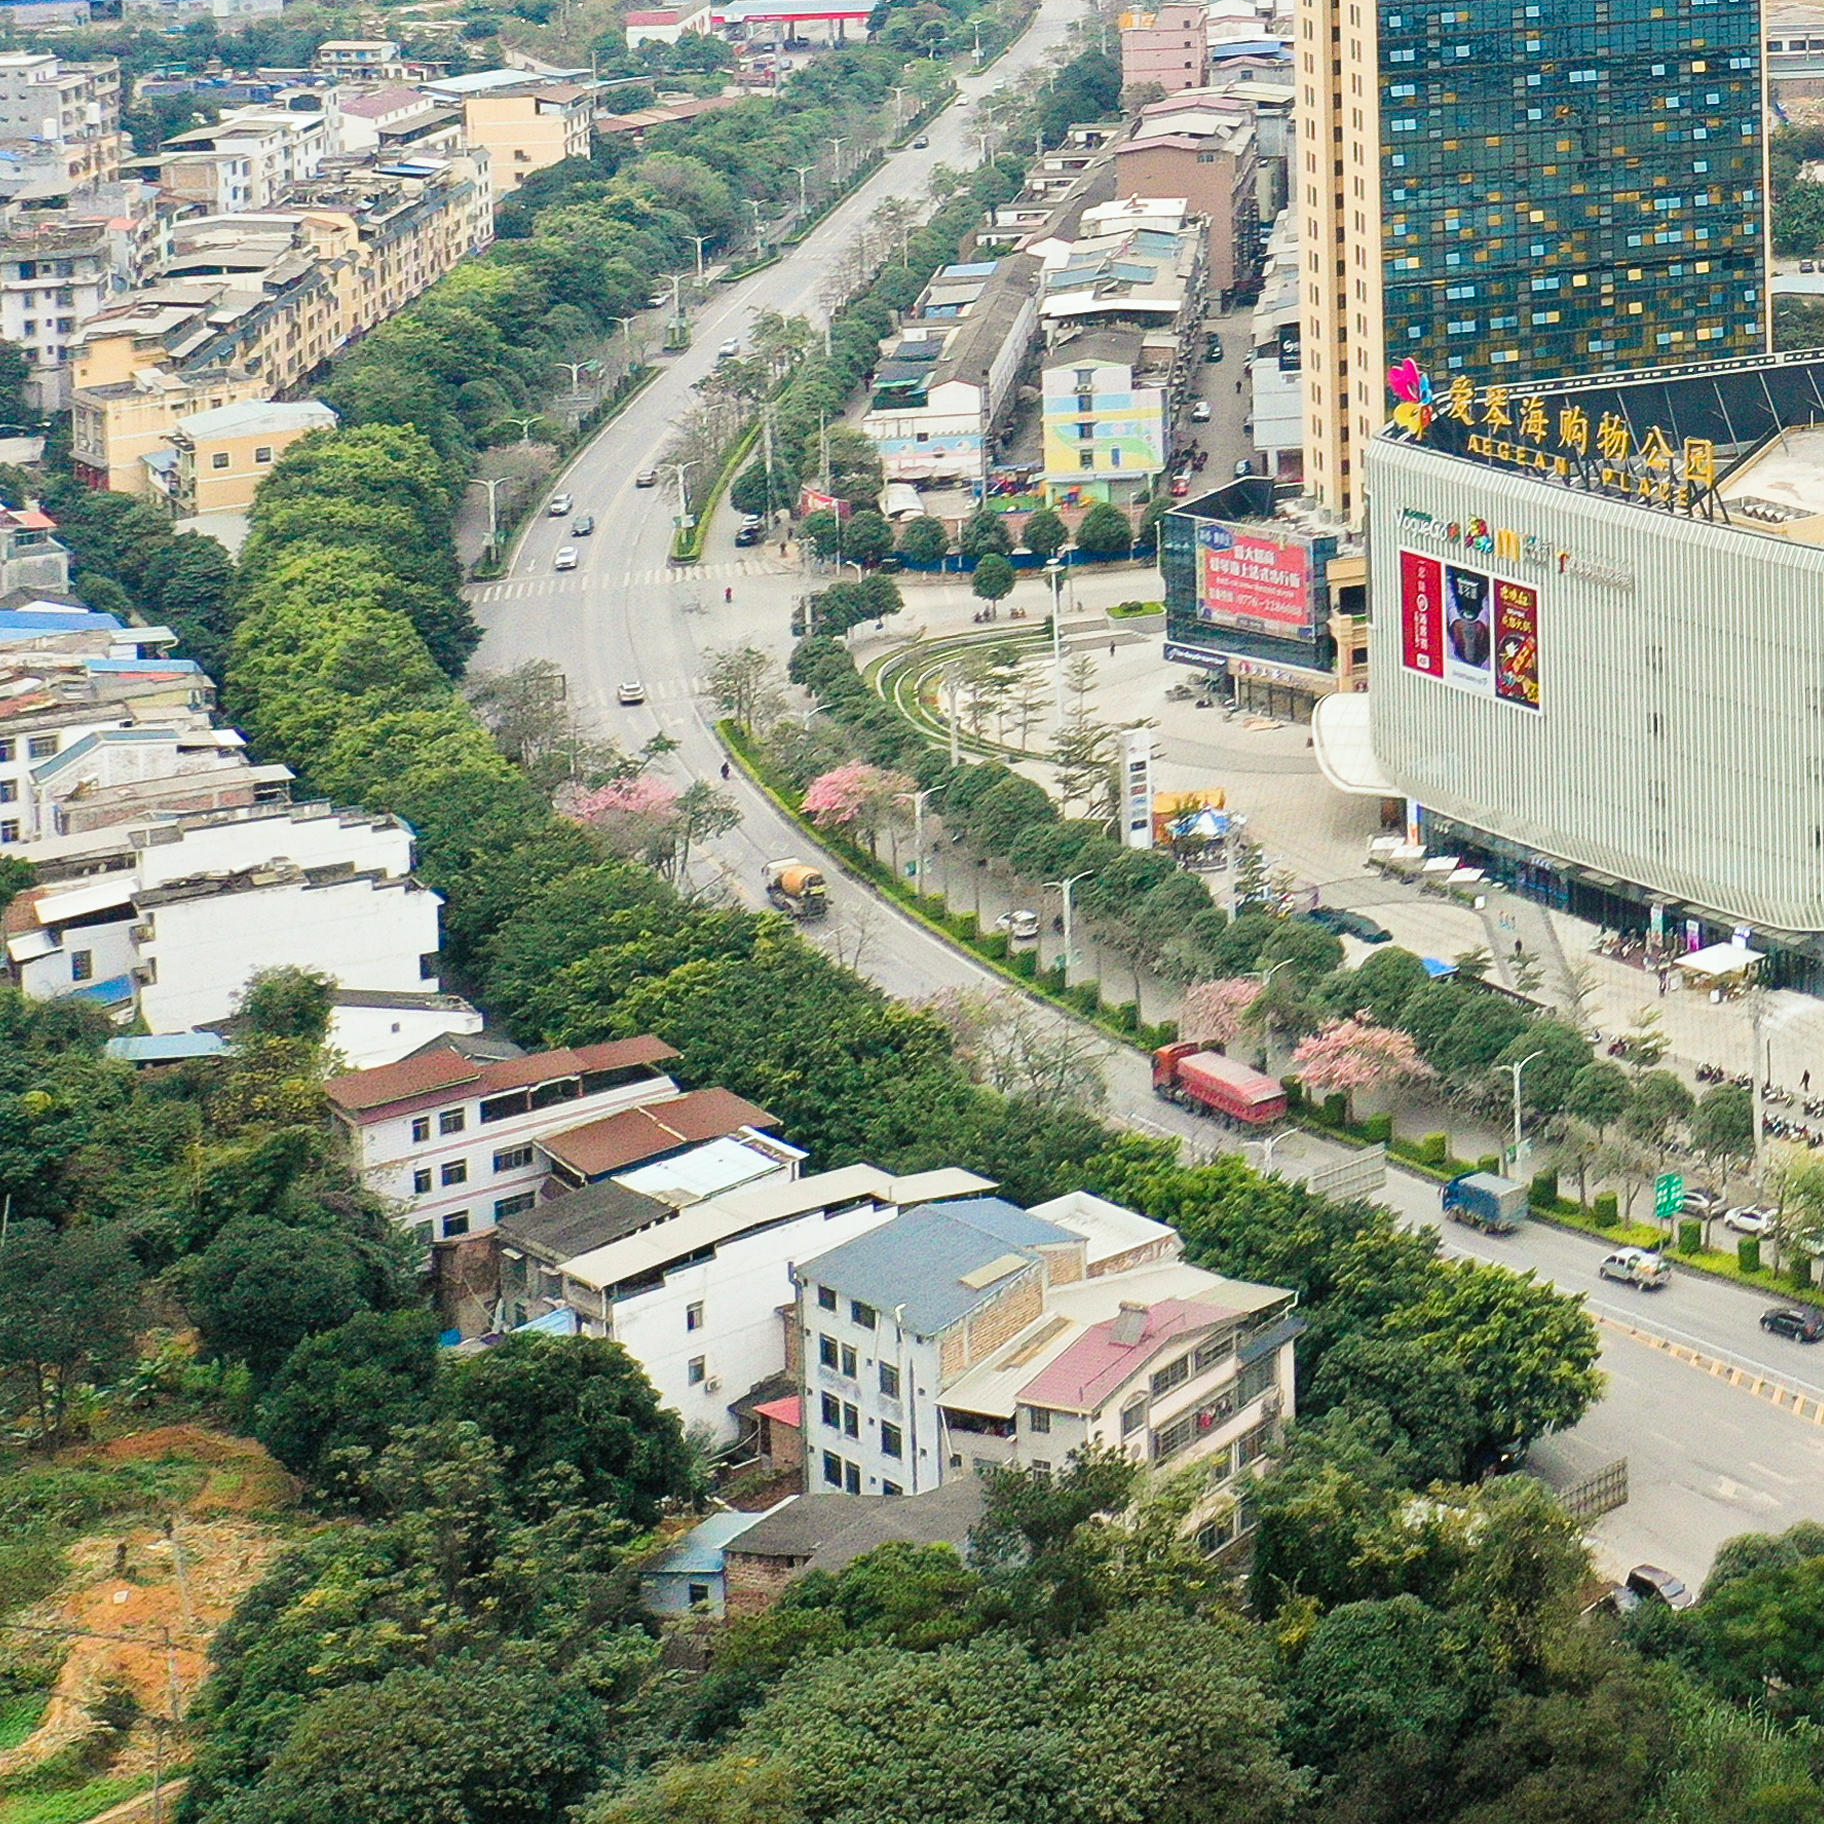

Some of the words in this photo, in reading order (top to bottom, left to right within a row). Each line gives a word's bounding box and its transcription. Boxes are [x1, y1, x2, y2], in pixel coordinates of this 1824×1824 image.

[1447, 375, 1715, 487] 爱琴海购物公园
[1467, 434, 1571, 476] AEGEAN
[1602, 468, 1690, 507] PLACE
